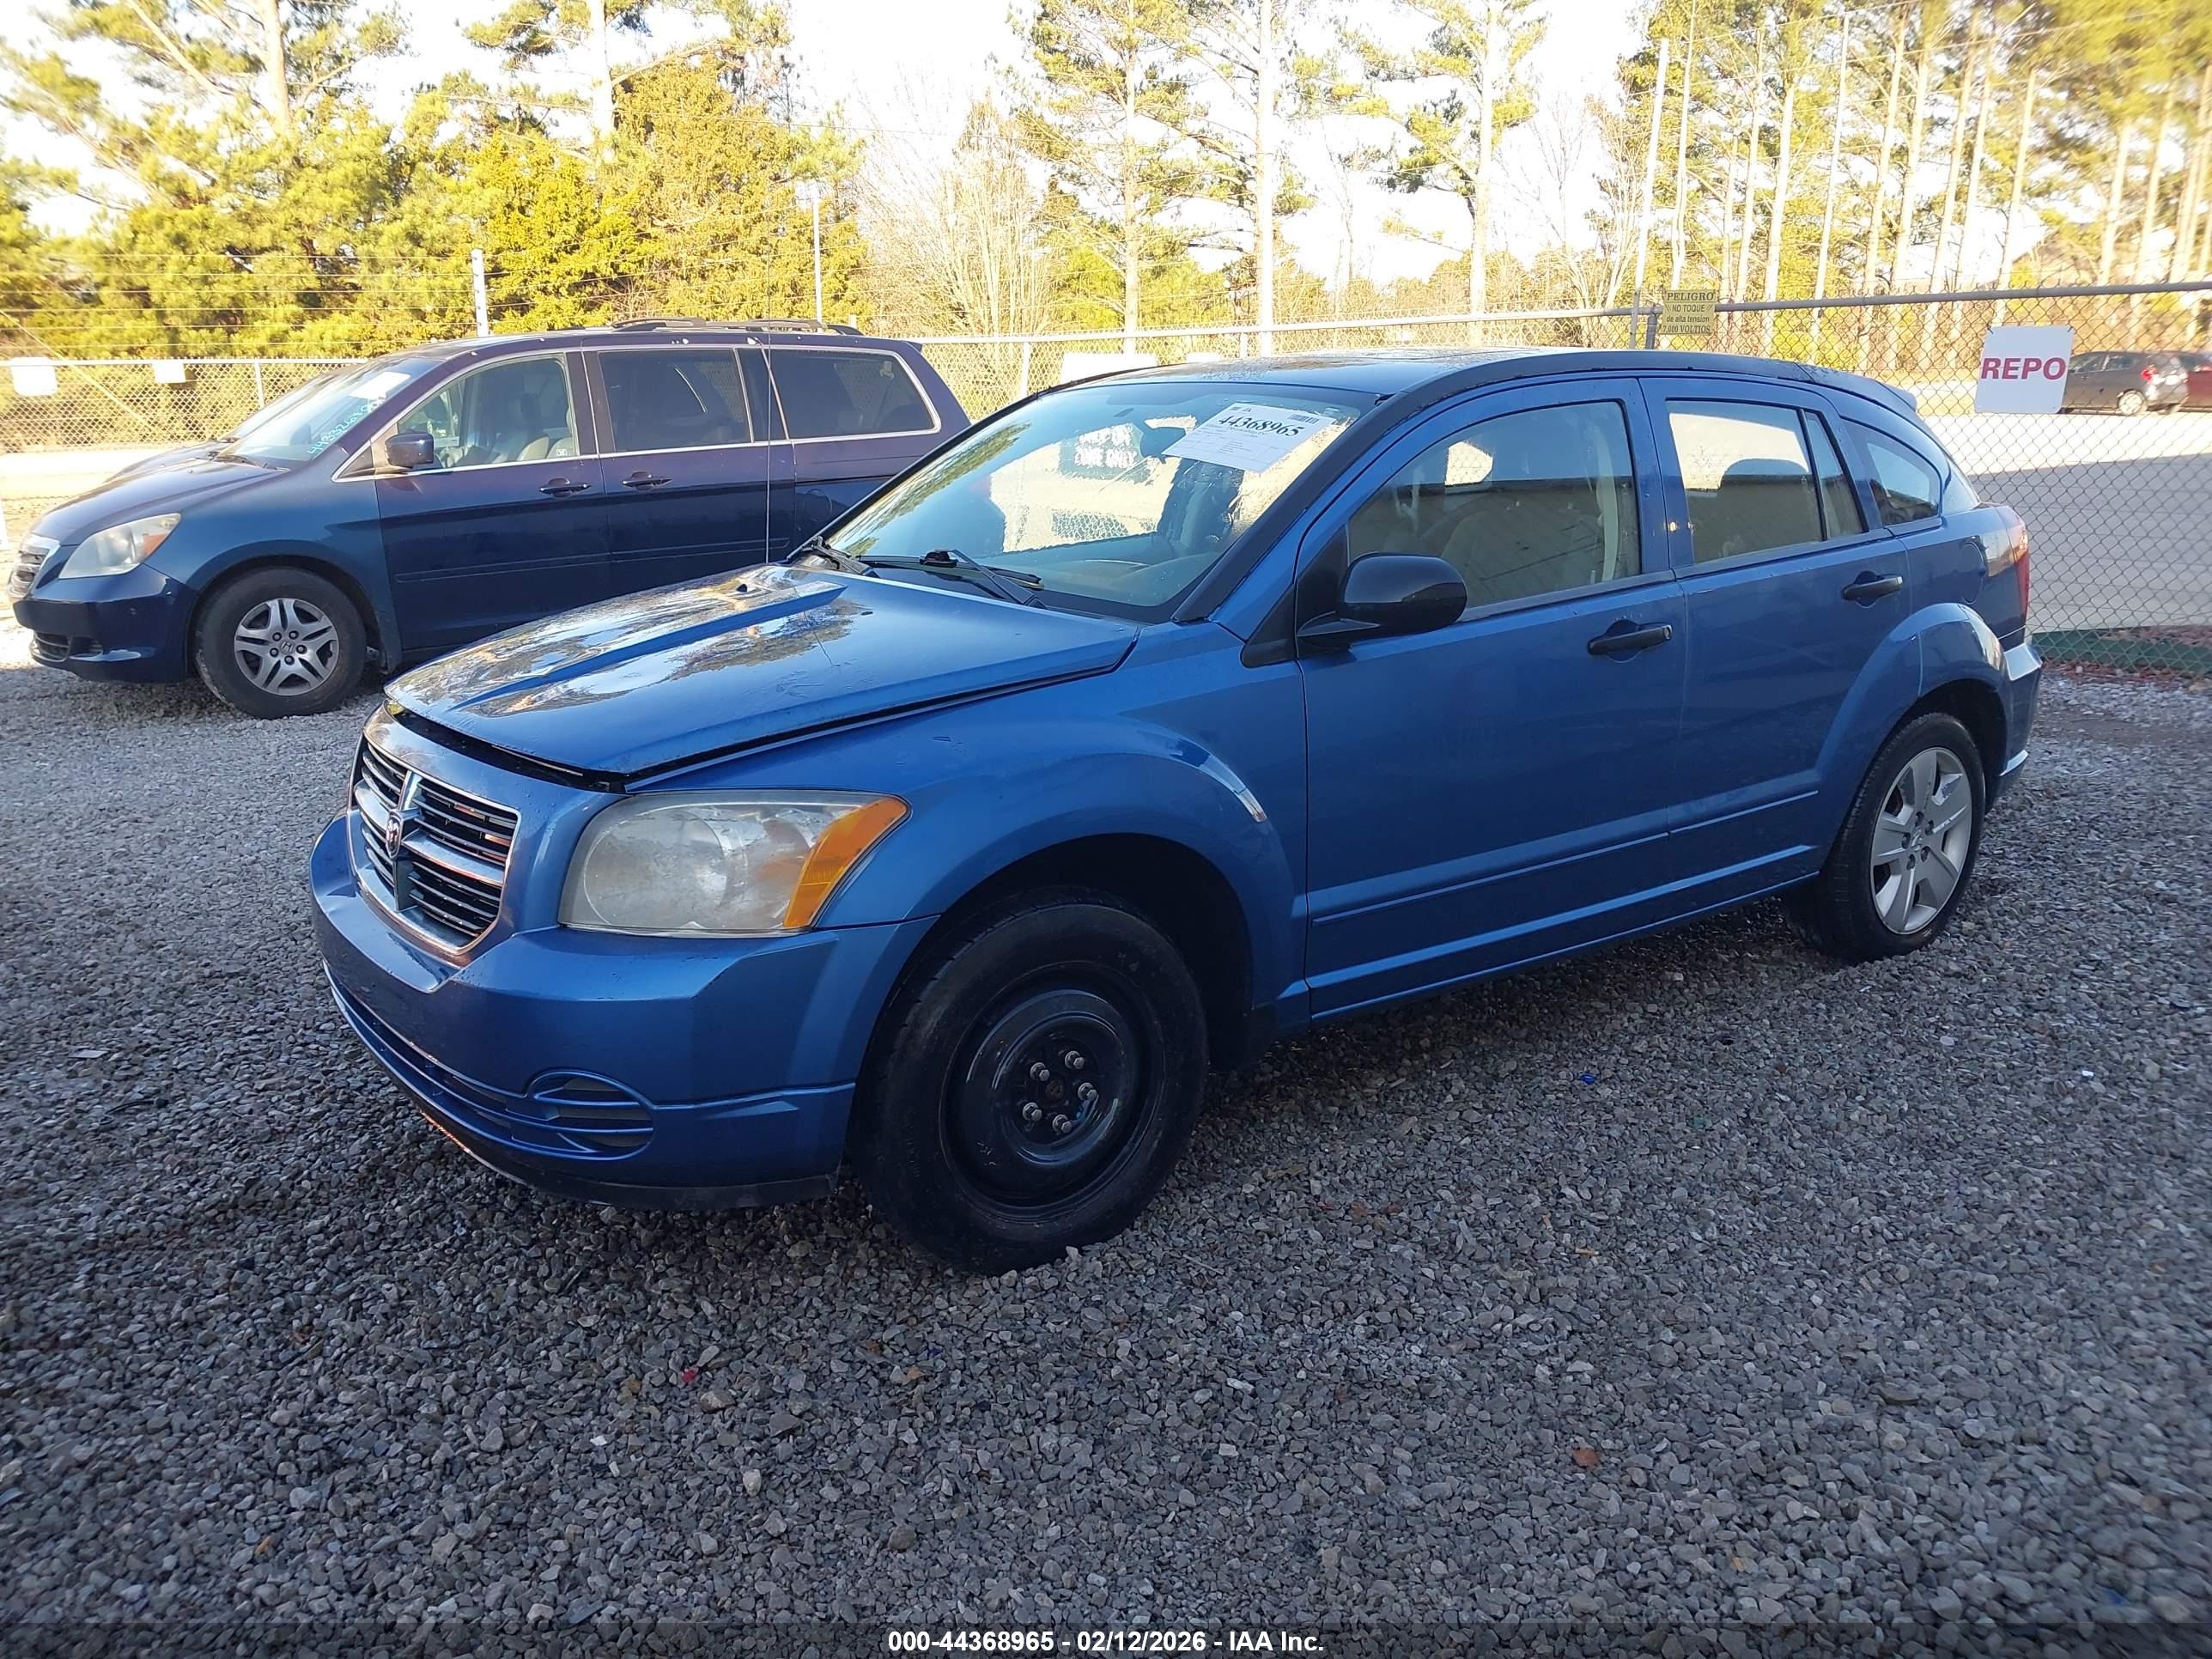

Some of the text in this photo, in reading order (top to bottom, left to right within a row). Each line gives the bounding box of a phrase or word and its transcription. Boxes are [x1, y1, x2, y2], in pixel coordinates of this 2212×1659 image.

[1667, 292, 1714, 301] PELIGRO
[1672, 304, 1705, 313] NO TOQUE
[1981, 357, 2066, 380] REPO
[1218, 415, 1305, 437] 44368965
